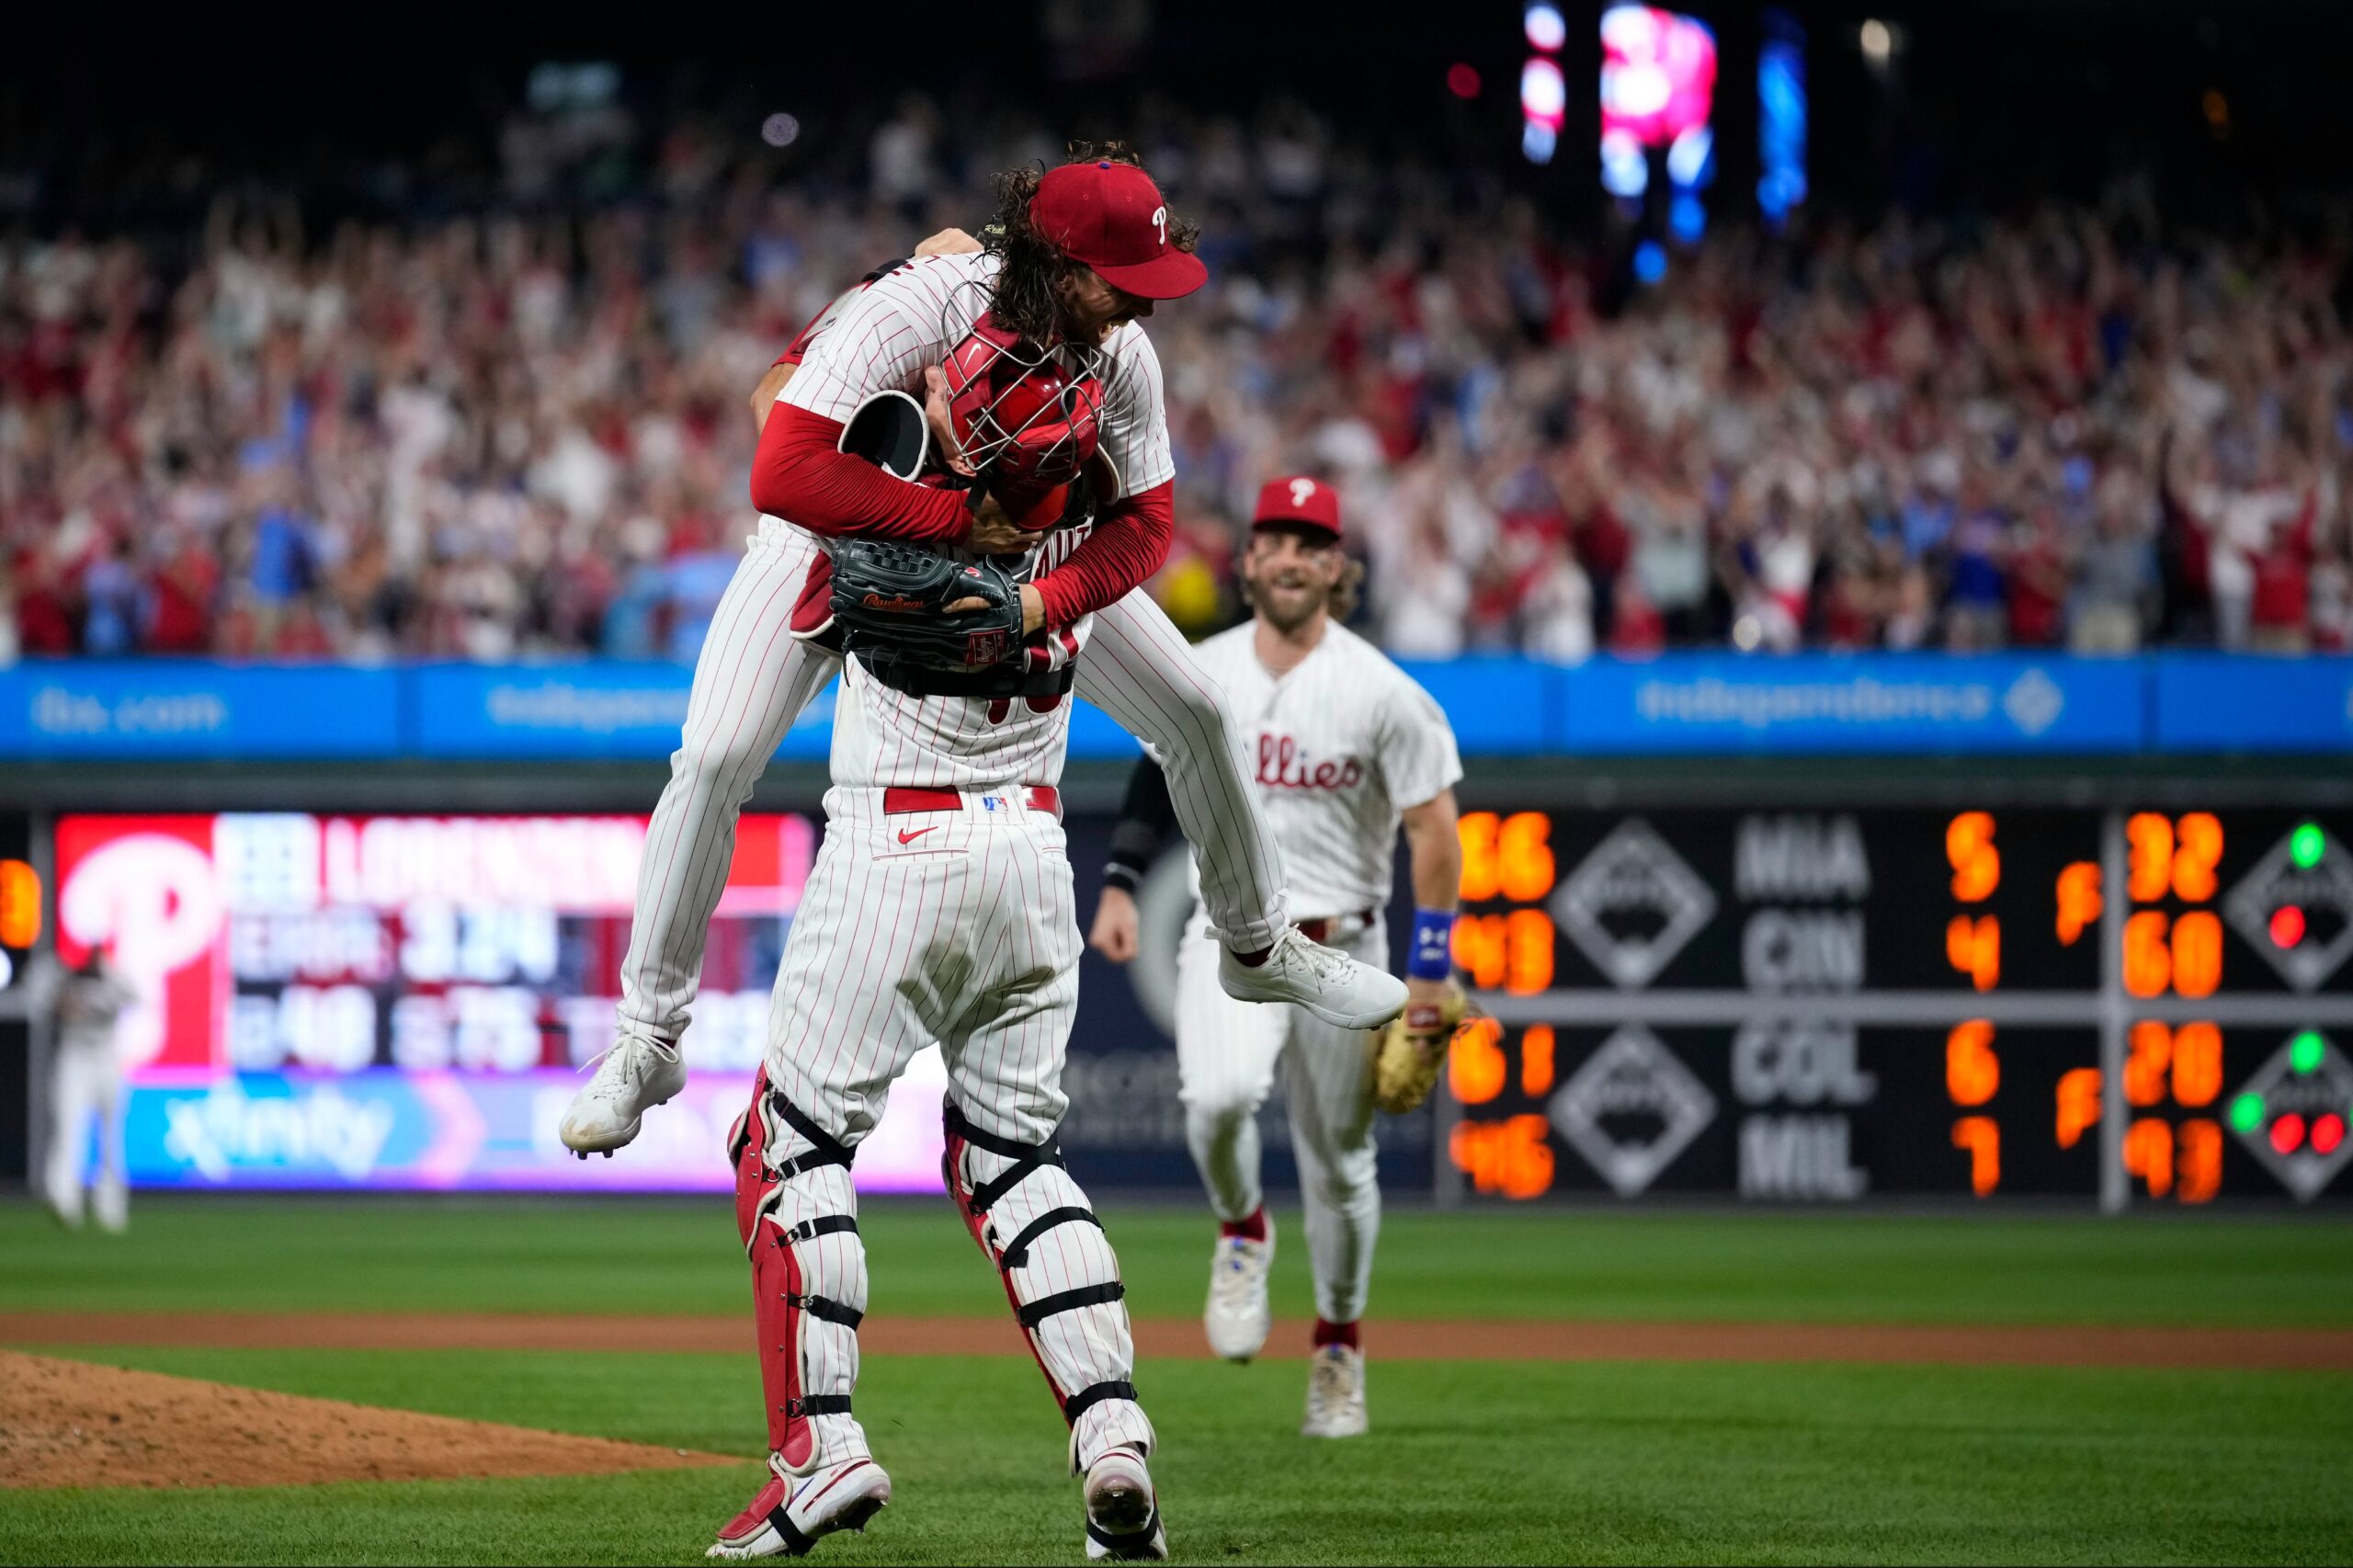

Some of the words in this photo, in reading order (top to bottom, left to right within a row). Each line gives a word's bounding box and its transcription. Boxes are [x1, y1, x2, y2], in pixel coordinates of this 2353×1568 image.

[1152, 206, 1167, 245] P
[1289, 477, 1317, 506] P
[863, 593, 925, 610] Rawlings
[1256, 731, 1364, 790] llies
[1734, 814, 1870, 903] MIA
[1946, 811, 2001, 902] 5
[1742, 907, 1864, 994] CIN
[1946, 915, 2001, 992] 4
[1730, 1018, 1875, 1106] COL
[1946, 1018, 2001, 1106] 6
[1737, 1115, 1870, 1199] MIL
